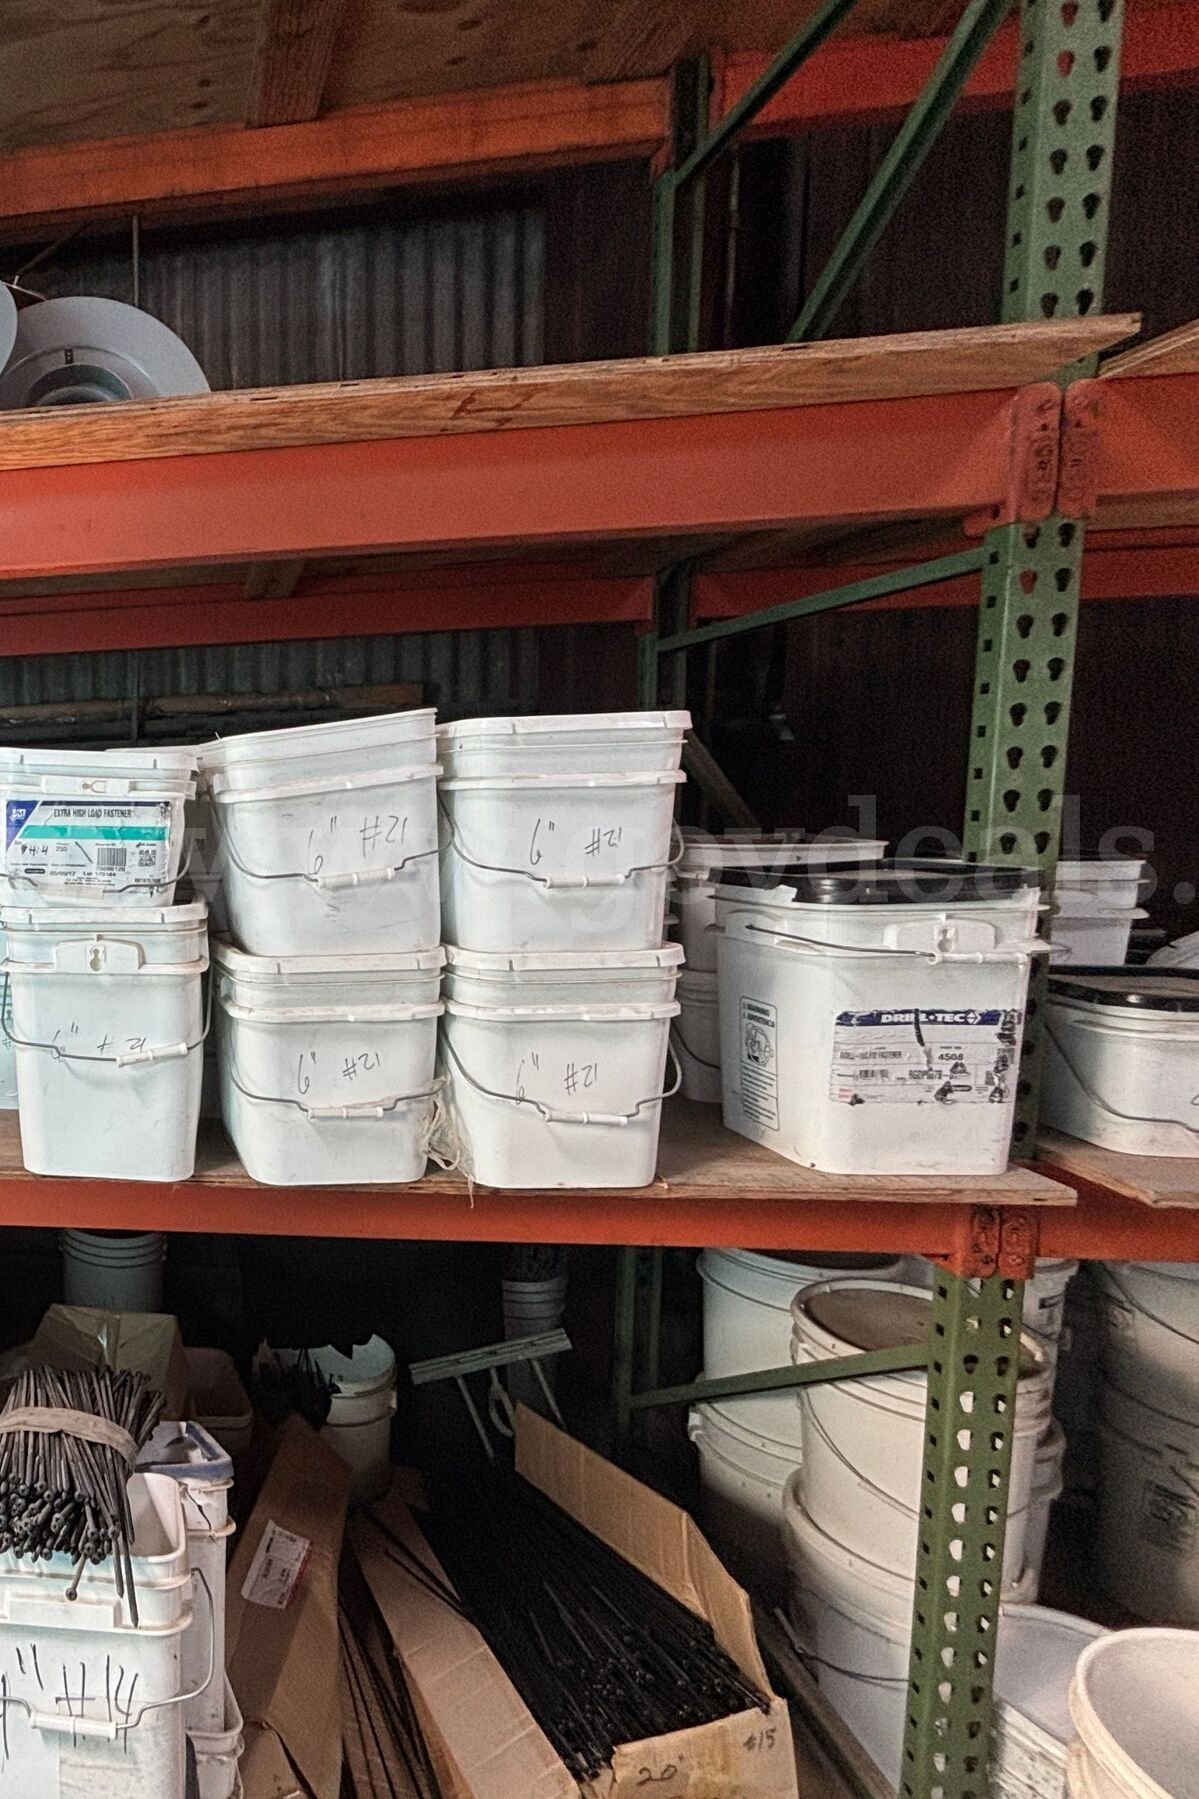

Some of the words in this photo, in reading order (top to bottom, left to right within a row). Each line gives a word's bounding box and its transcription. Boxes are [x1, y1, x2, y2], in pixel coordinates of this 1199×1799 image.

[54, 808, 71, 818] EXTRA
[73, 808, 87, 818] HIGH
[88, 808, 102, 819] LOAD
[103, 808, 133, 818] FASTENER
[360, 815, 409, 858] #21
[584, 826, 622, 857] #21
[341, 1053, 381, 1081] #21
[563, 1063, 599, 1097] #21
